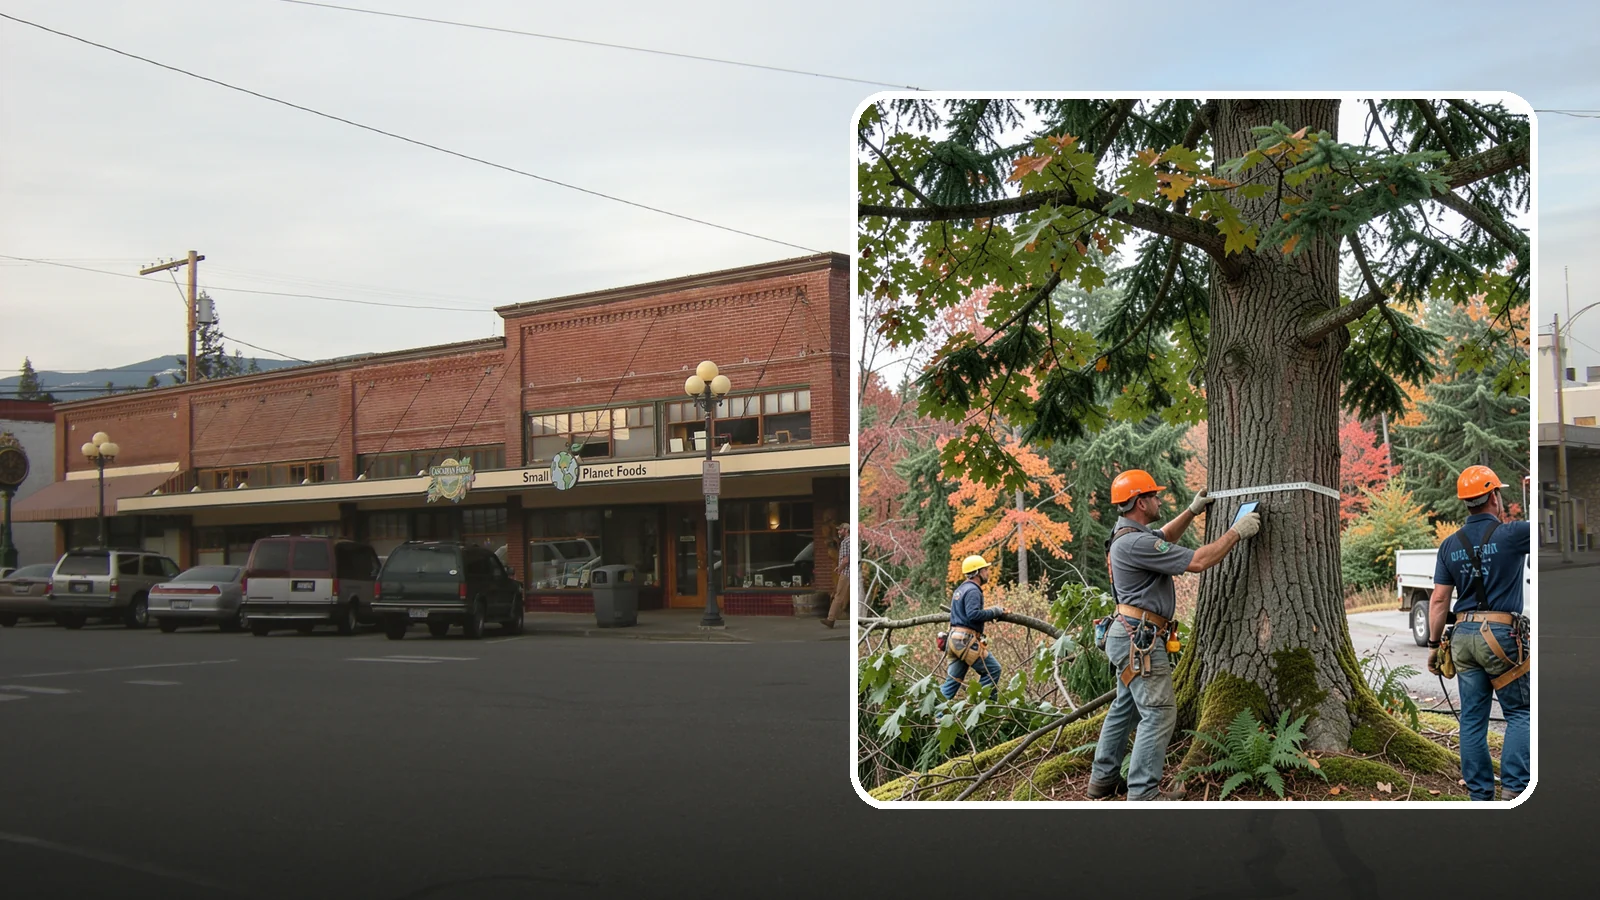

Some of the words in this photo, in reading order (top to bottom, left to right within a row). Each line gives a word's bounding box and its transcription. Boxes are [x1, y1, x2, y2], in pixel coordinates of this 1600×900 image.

[523, 471, 549, 483] Small
[583, 468, 614, 479] Planet
[617, 464, 647, 477] Foods
